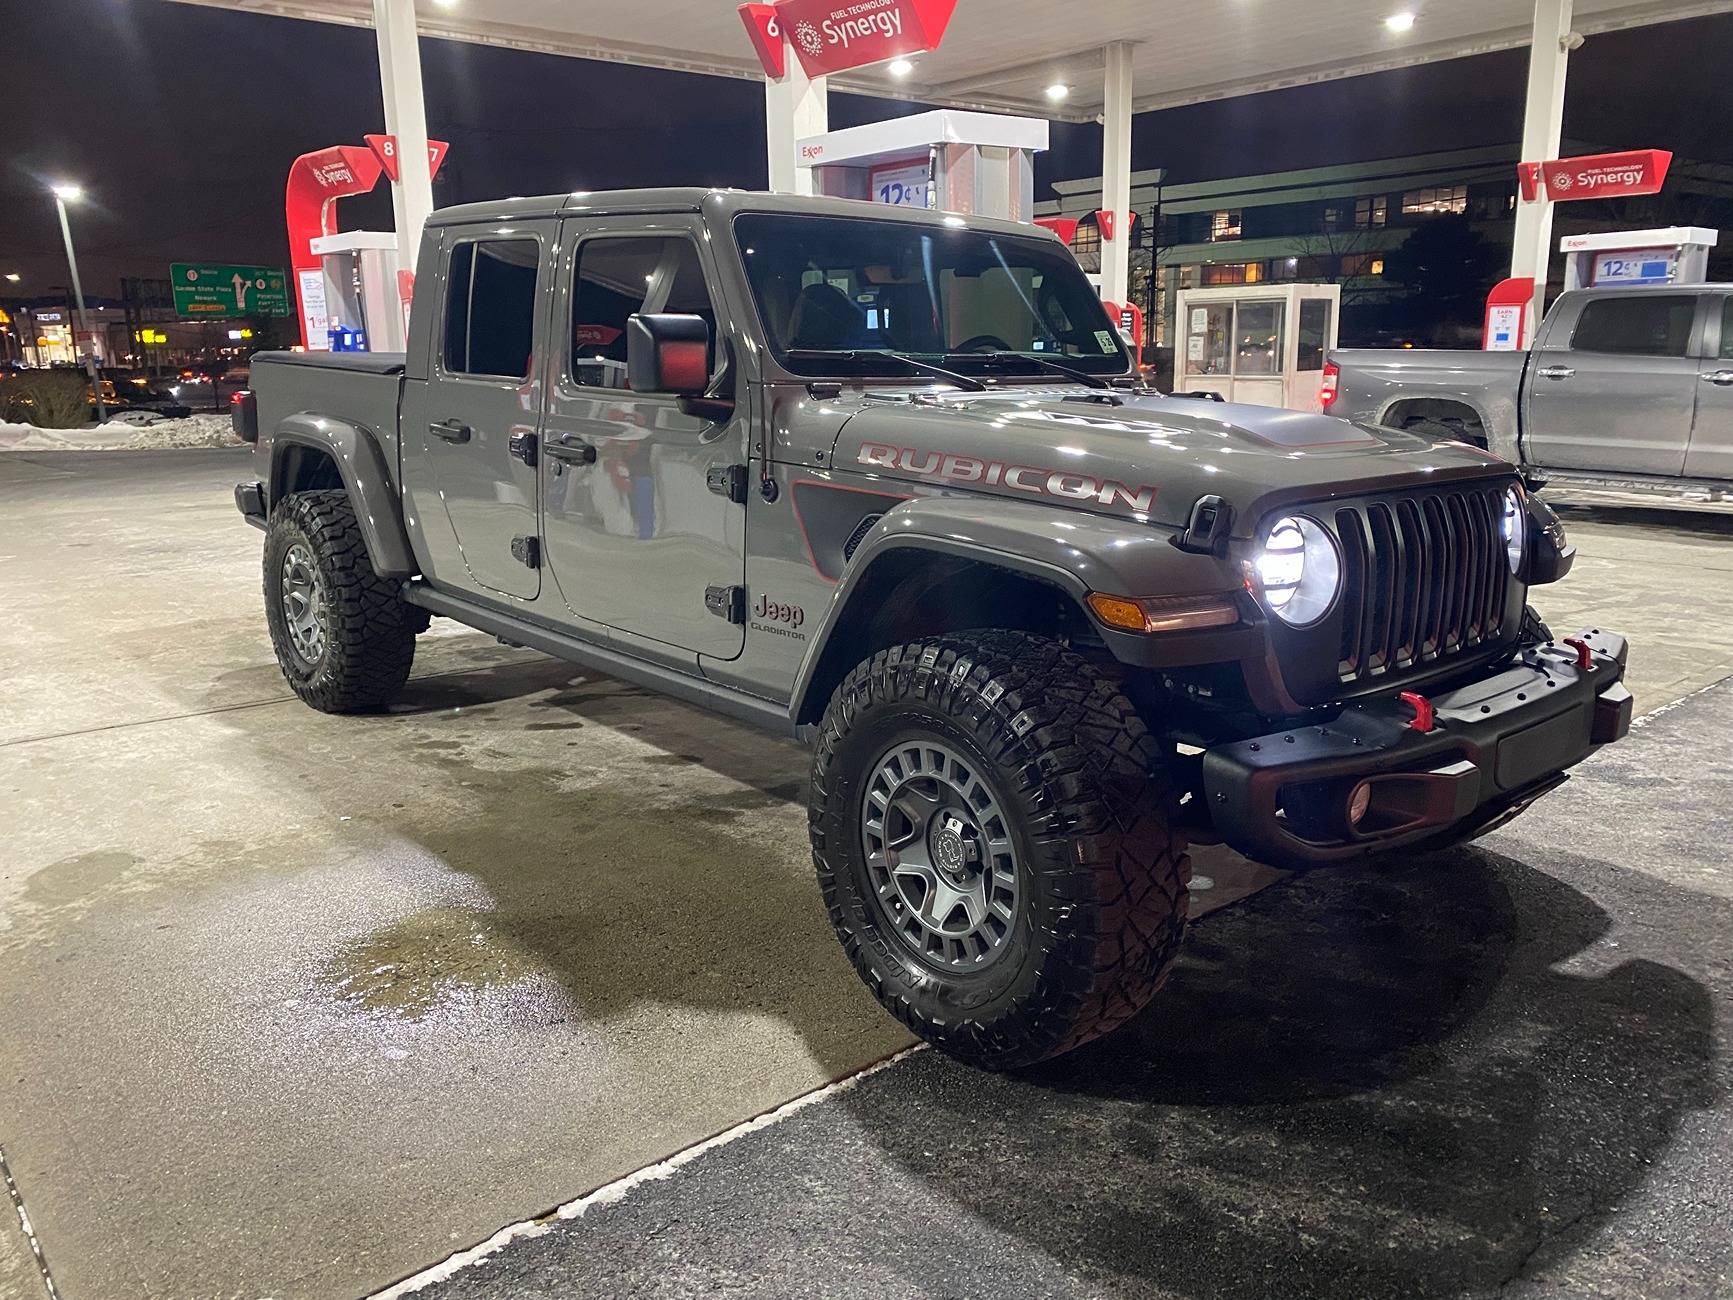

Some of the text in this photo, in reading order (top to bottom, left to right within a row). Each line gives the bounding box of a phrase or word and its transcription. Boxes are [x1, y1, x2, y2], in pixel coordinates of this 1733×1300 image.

[830, 9, 848, 20] FUEL
[767, 16, 779, 37] 6
[822, 8, 902, 48] Synergy
[383, 141, 395, 156] 8
[429, 148, 439, 162] 7
[802, 145, 824, 159] Exxon
[322, 169, 354, 186] Synergy
[1577, 169, 1644, 189] Synergy
[1107, 215, 1112, 225] 4
[856, 441, 1161, 515] RUBICON
[753, 592, 805, 630] Jeep
[750, 622, 806, 641] GLADIATOR
